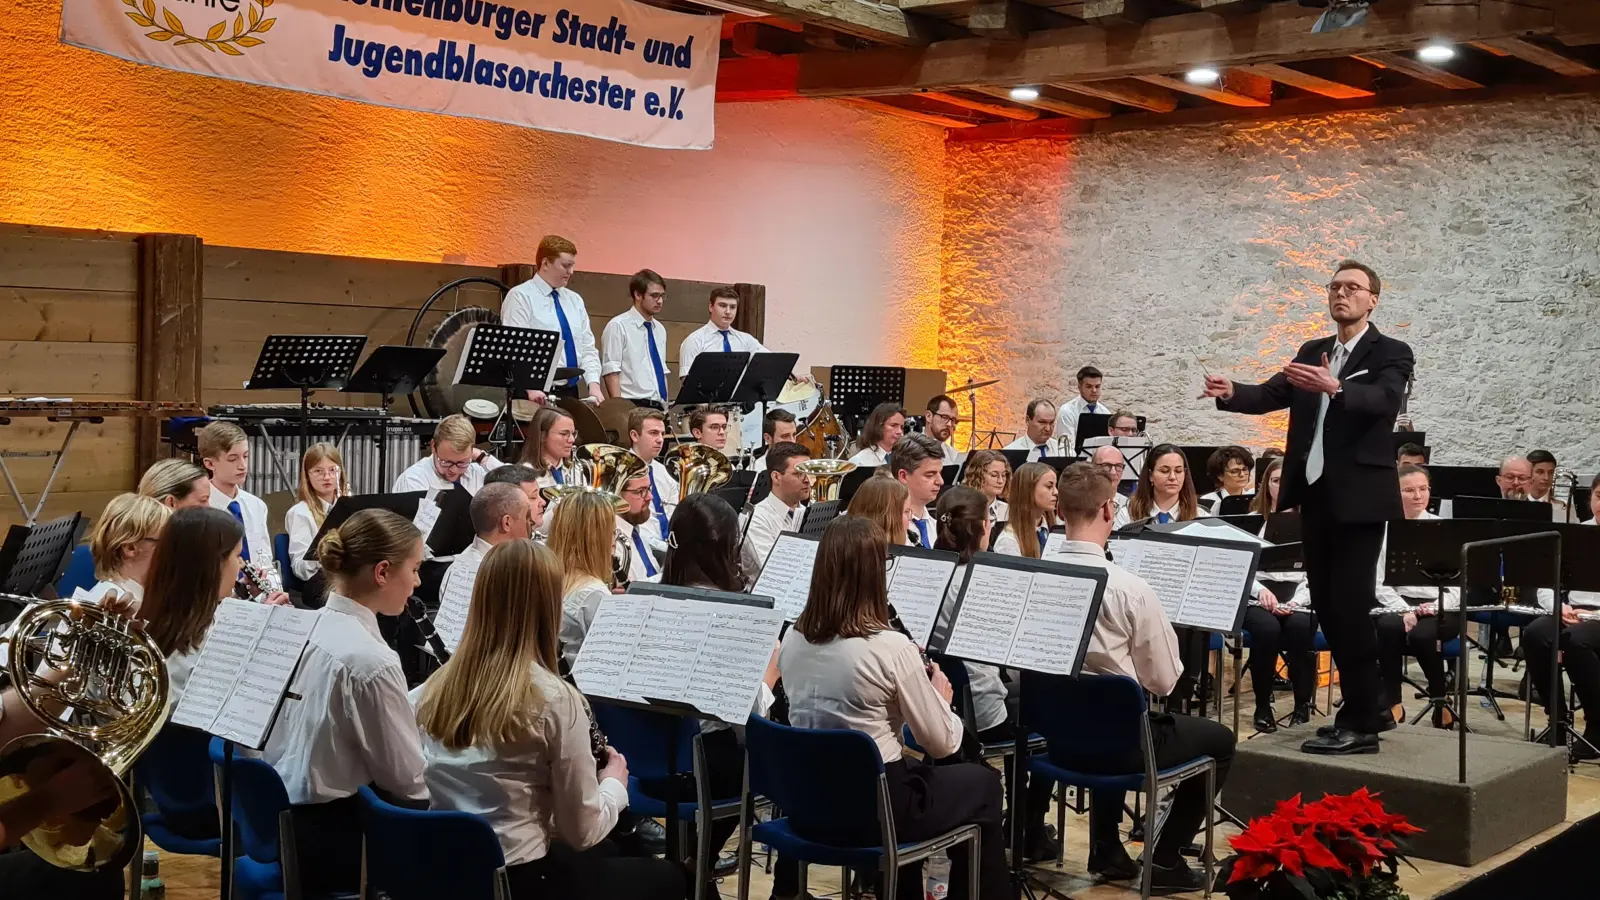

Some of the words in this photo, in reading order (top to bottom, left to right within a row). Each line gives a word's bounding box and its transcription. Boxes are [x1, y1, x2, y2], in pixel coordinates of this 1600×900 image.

[328, 24, 636, 111] Jugendblasorchester
[644, 86, 685, 120] e.V.
[342, 0, 546, 40] enburger
[552, 9, 635, 55] Stadt-
[643, 35, 694, 69] und
